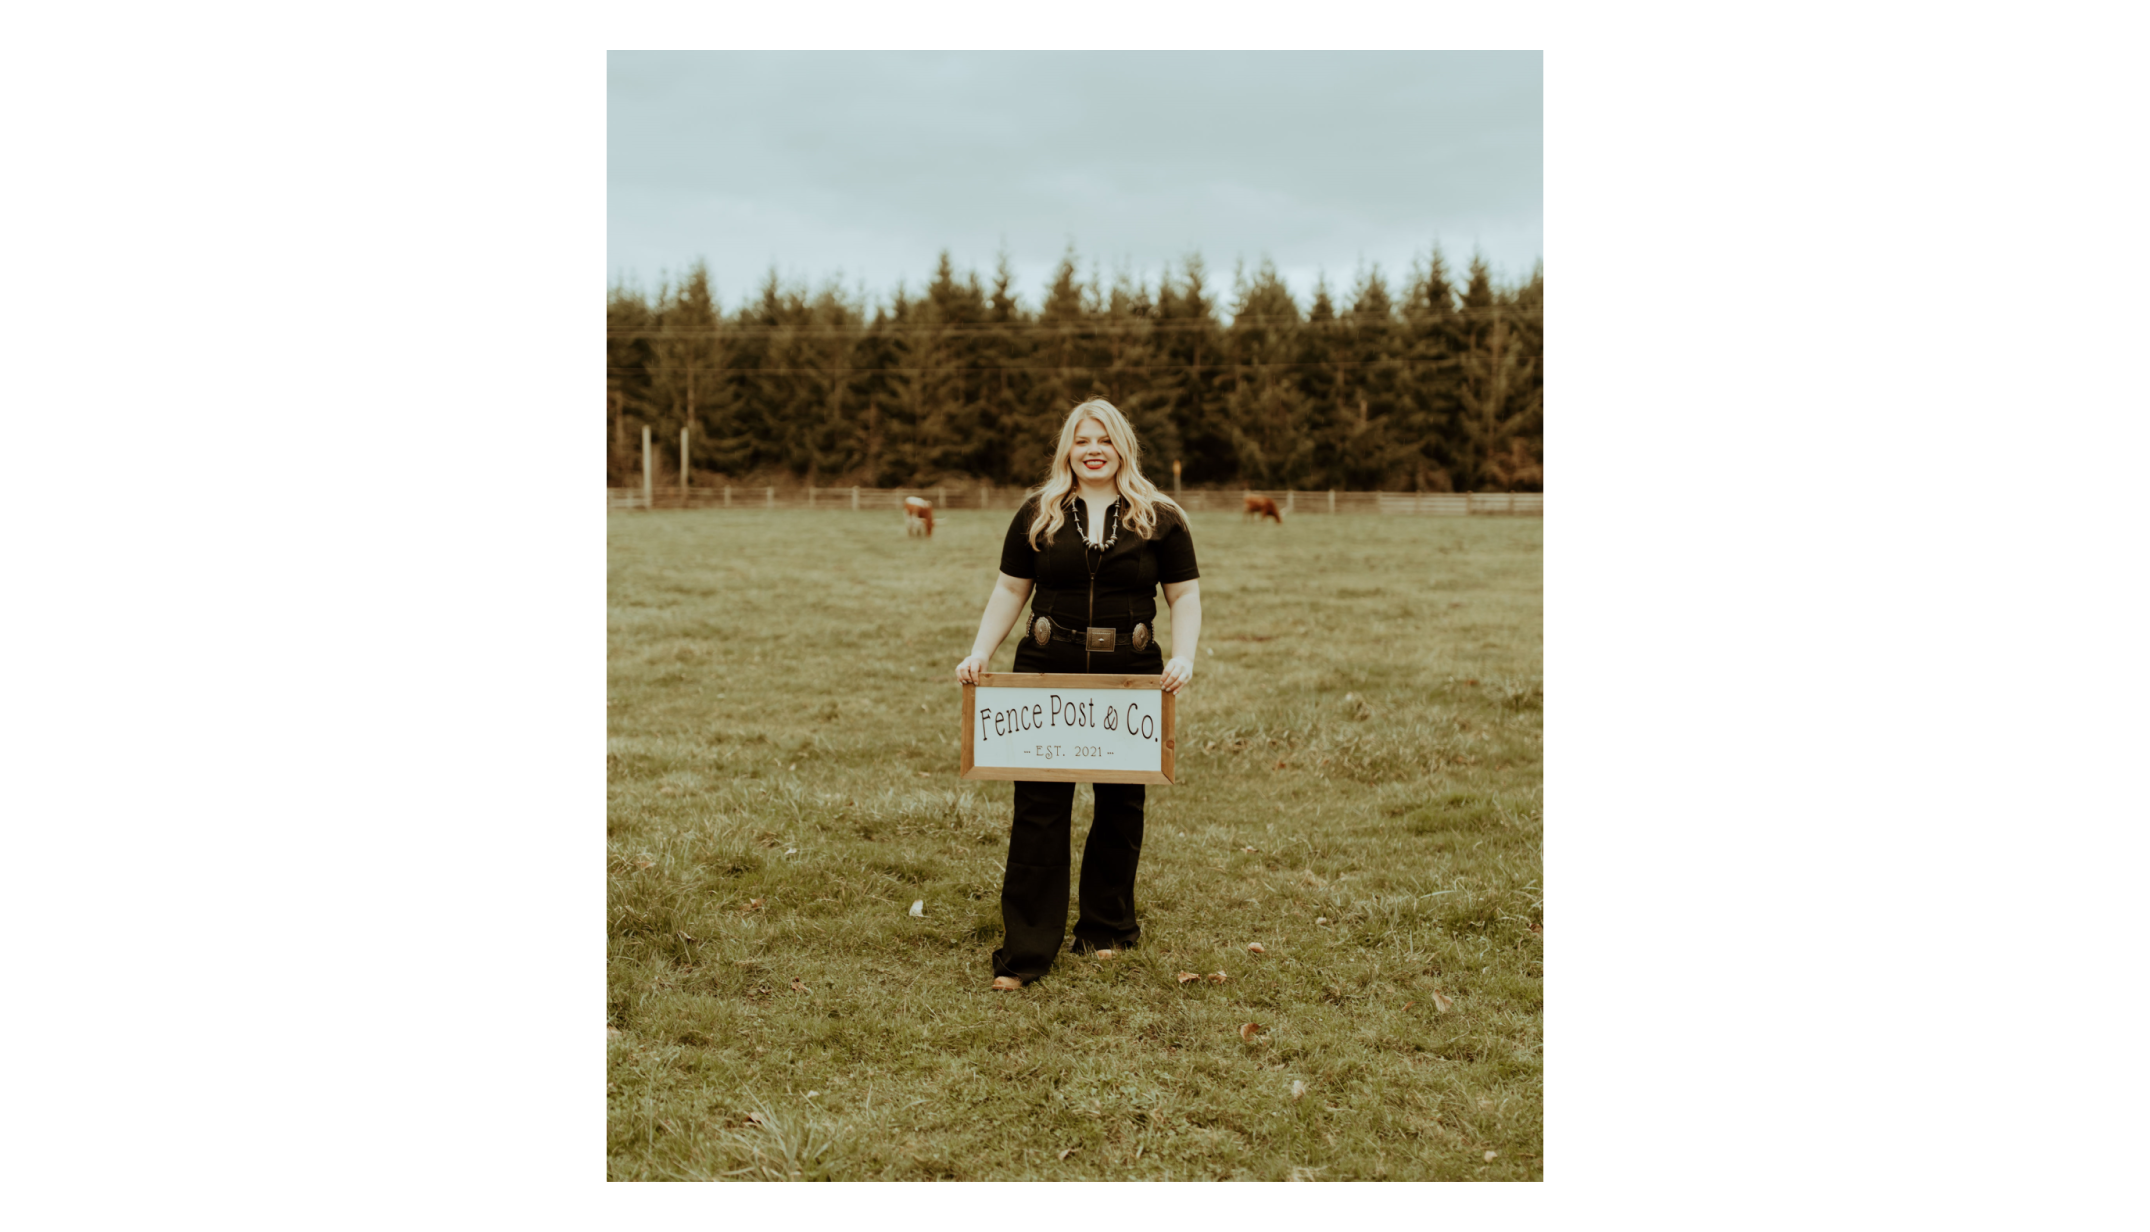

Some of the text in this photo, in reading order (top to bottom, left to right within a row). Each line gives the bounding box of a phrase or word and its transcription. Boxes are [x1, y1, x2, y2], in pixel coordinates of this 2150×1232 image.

[980, 694, 1159, 743] Fence Post & Co.
[1035, 745, 1103, 760] EST. 2021
